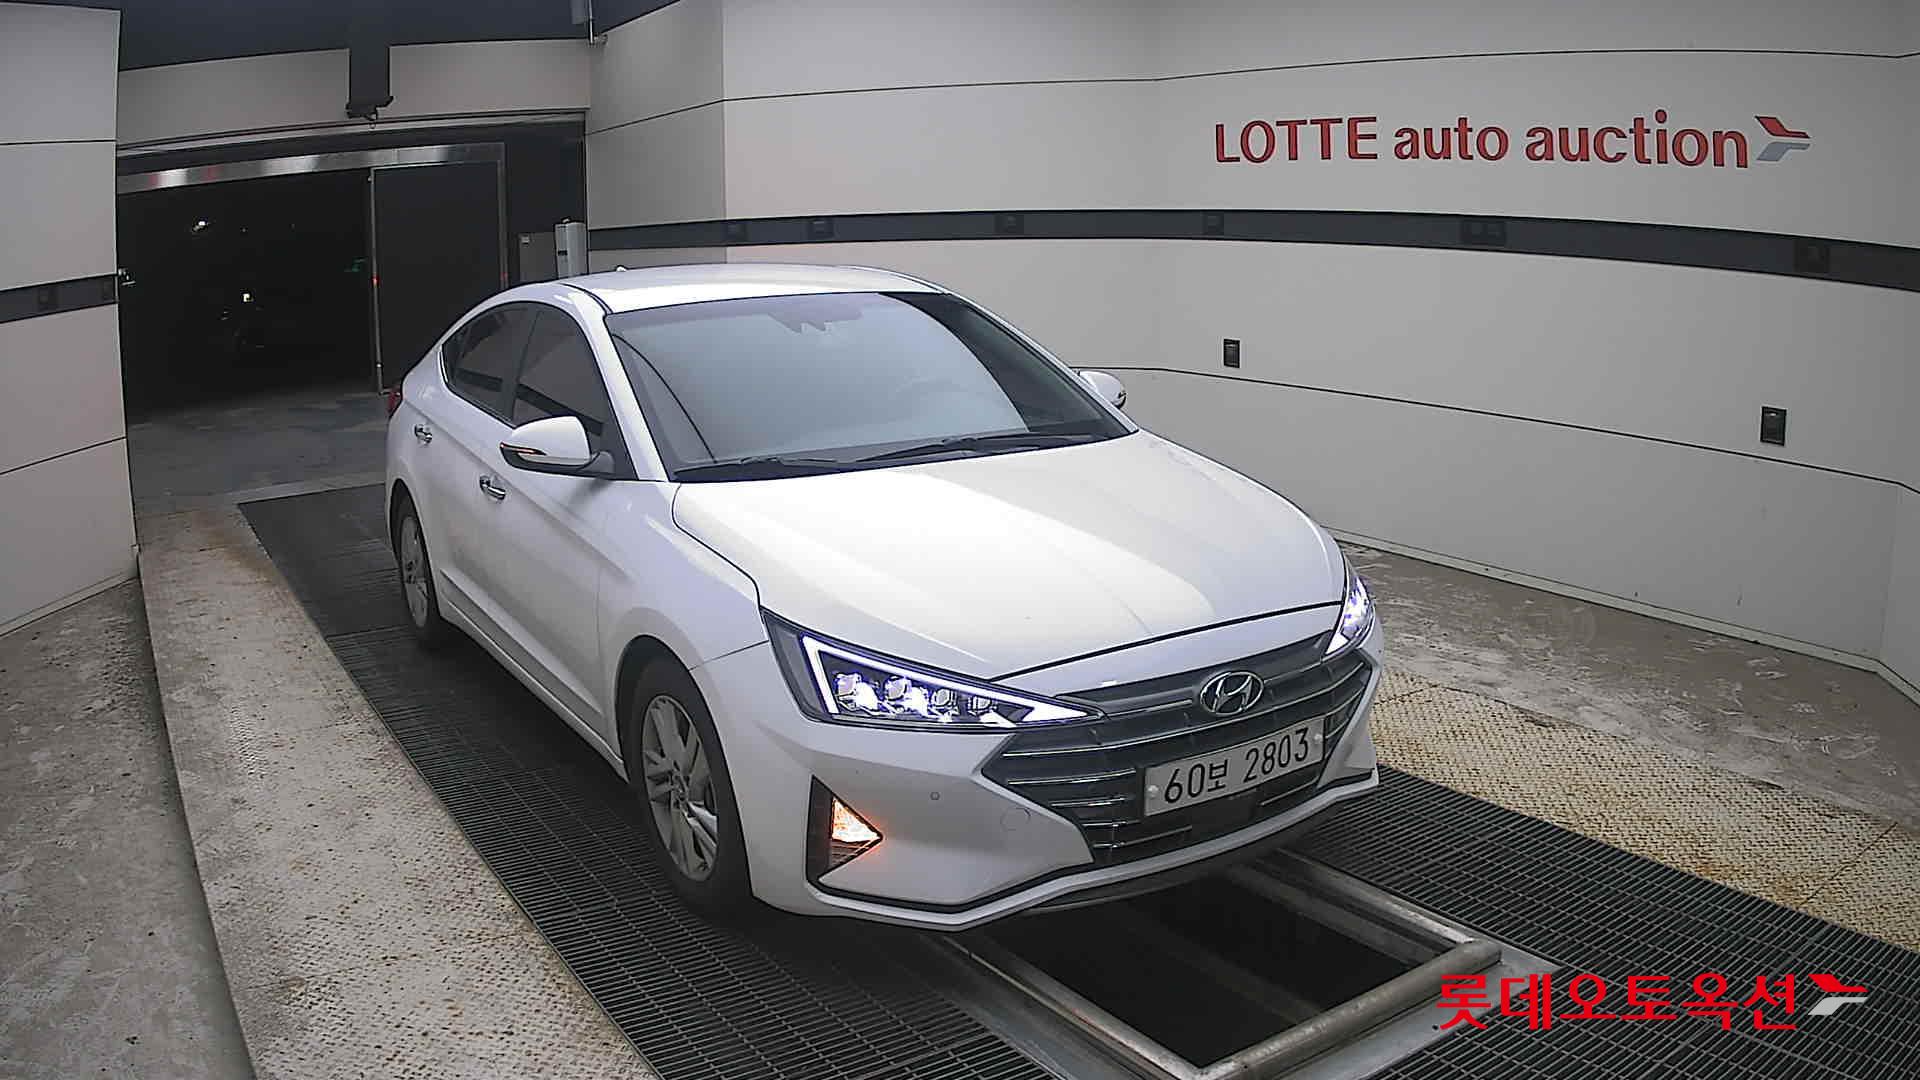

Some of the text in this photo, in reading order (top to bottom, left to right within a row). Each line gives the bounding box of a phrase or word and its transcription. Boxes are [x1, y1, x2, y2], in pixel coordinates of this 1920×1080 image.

[1215, 110, 1749, 168] LOTTE auto auction
[1164, 728, 1309, 803] 60보 2803
